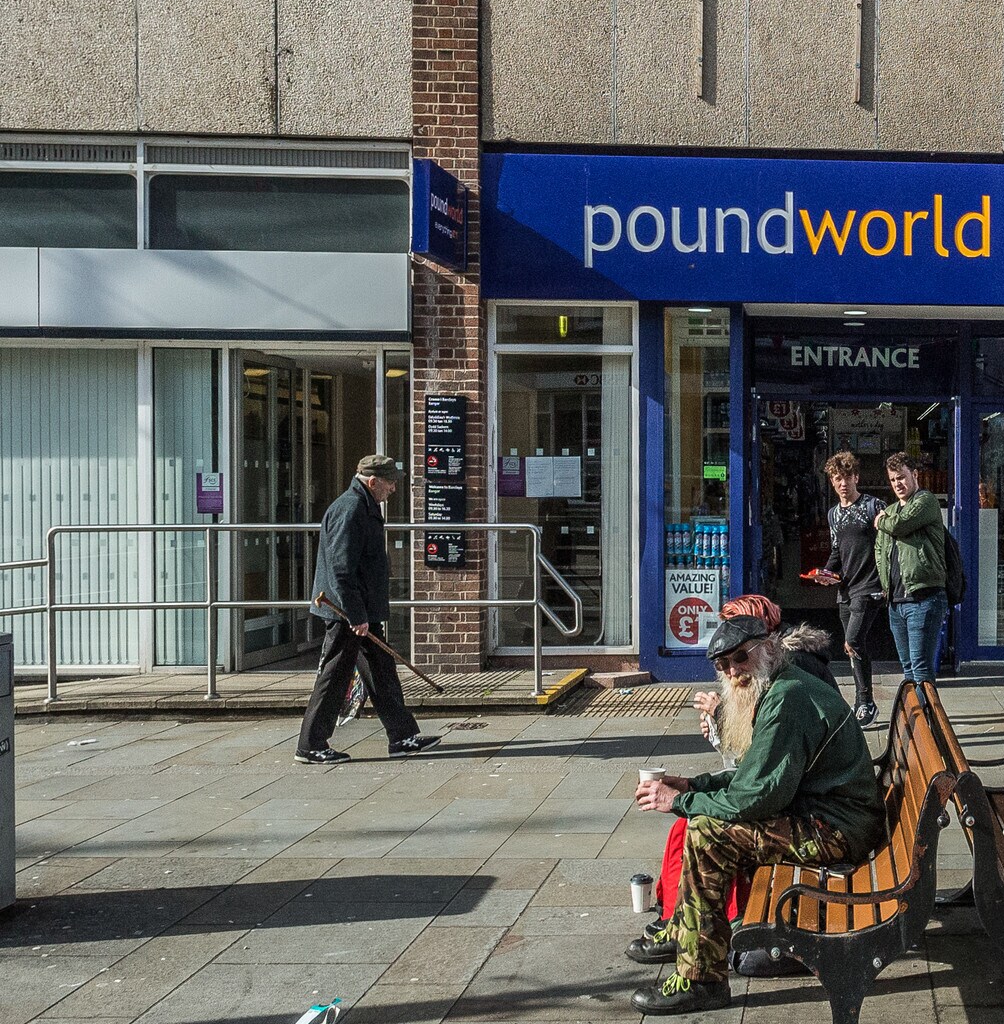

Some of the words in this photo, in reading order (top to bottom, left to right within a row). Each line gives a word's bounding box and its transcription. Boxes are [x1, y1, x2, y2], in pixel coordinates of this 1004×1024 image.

[431, 192, 464, 225] poundworld
[584, 191, 991, 268] poundworld
[791, 346, 920, 368] ENTRANCE
[669, 573, 716, 583] AMAZING
[672, 583, 713, 594] VALUE!
[677, 605, 707, 615] ONLY
